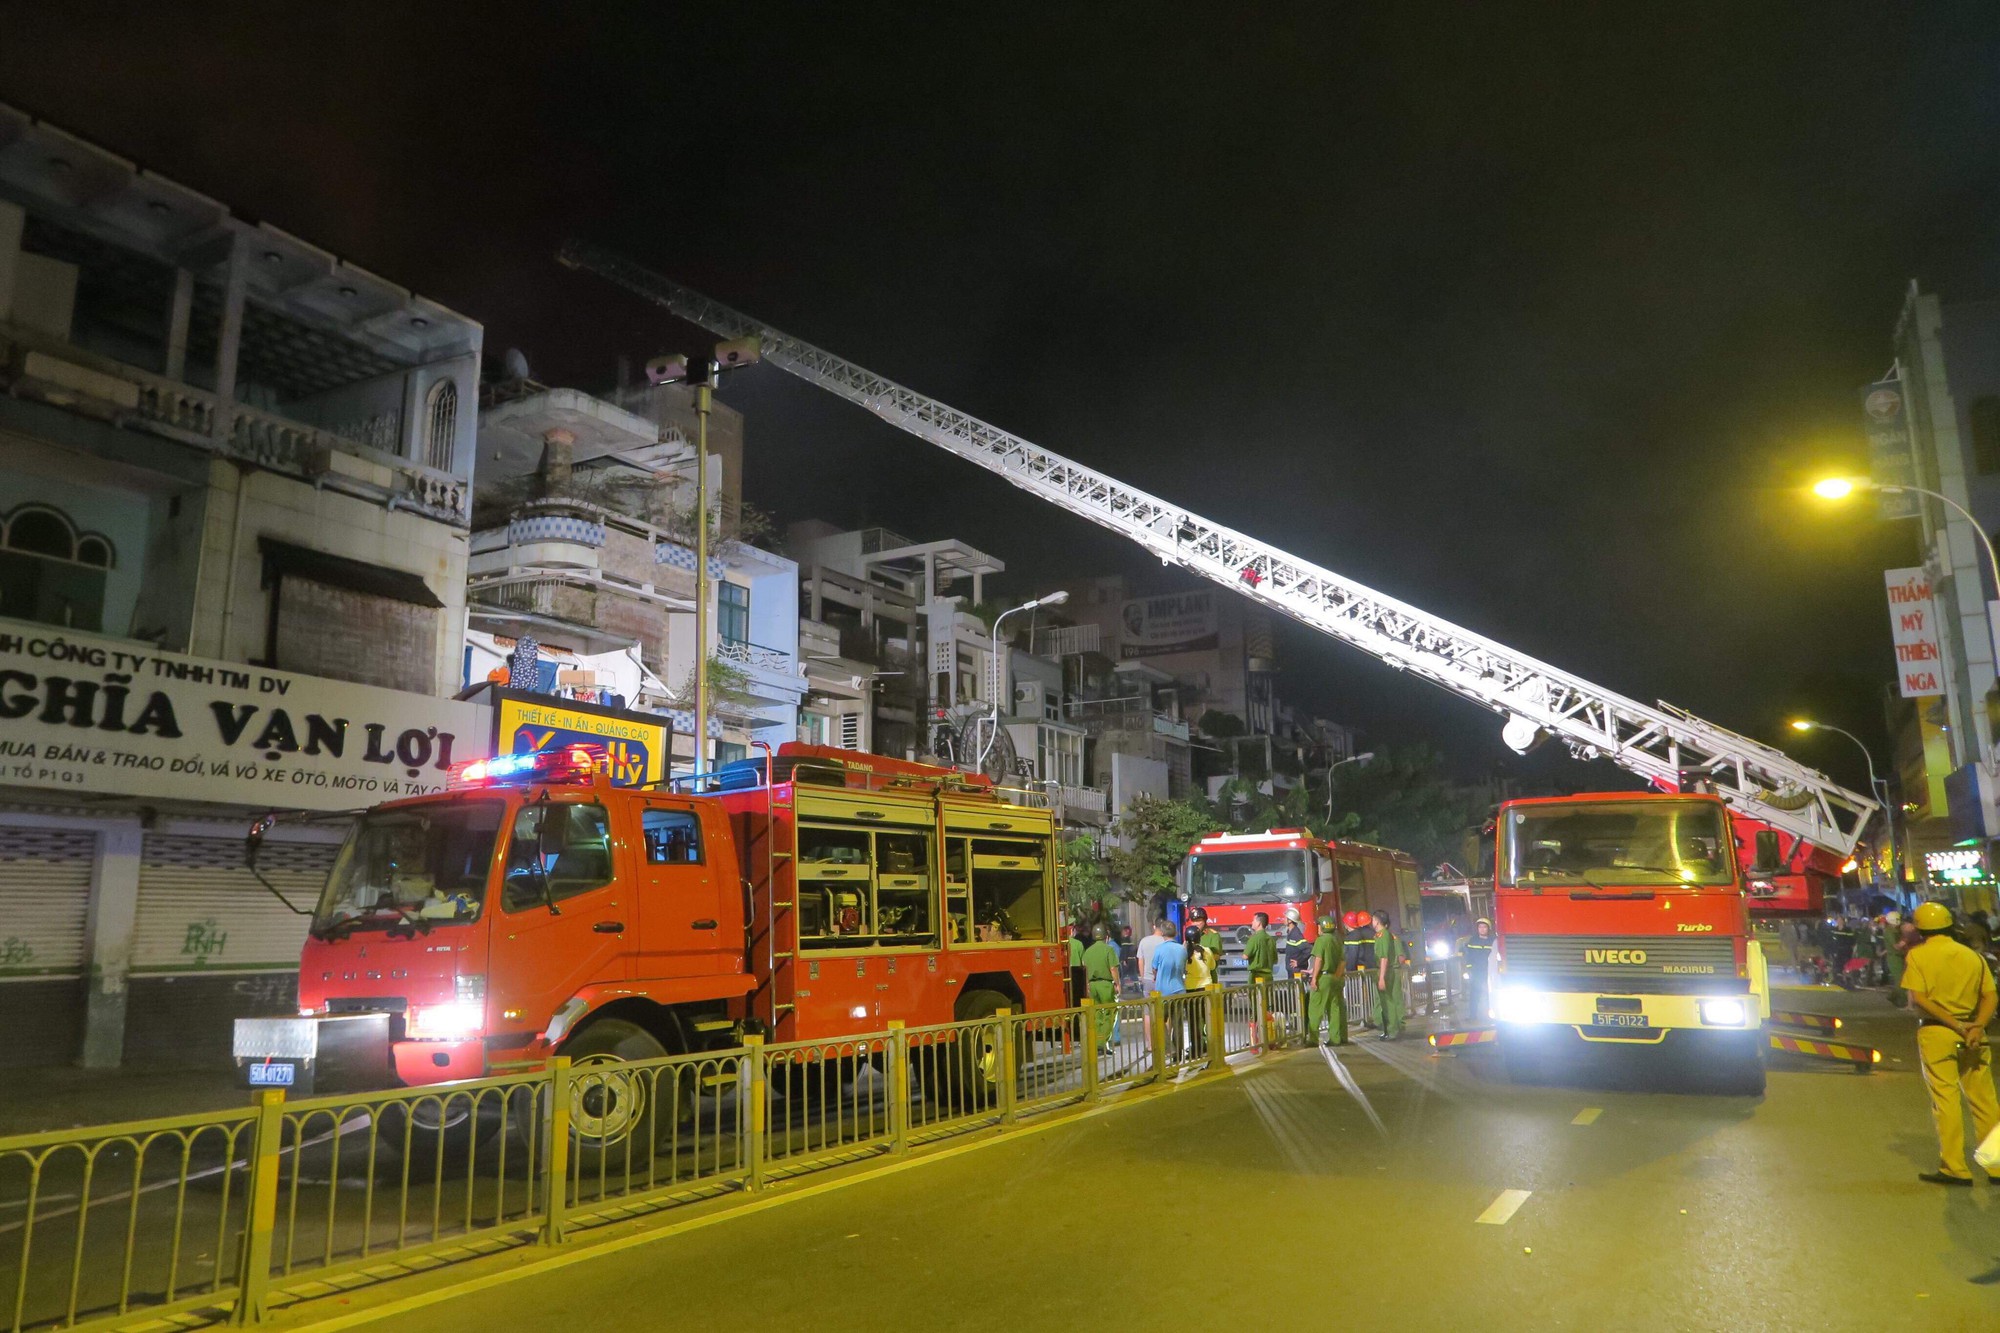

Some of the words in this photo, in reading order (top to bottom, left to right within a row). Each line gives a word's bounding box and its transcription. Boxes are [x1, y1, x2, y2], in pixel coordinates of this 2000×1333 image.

[28, 637, 106, 667] CÔNG
[112, 652, 146, 672] TY
[151, 658, 214, 684] TNHH
[218, 669, 250, 690] TM
[259, 677, 291, 695] DV
[1906, 672, 1937, 691] NGA
[544, 711, 556, 725] KẾ
[563, 717, 572, 728] IN
[596, 721, 628, 737] QUẢNG
[210, 700, 349, 761] VẠN
[363, 722, 456, 778] LỢI
[44, 743, 90, 762] BÁN
[92, 750, 106, 765] &
[112, 752, 164, 771] TRAO
[211, 760, 230, 777] VÁ
[262, 768, 286, 782] XE
[405, 783, 428, 795] TAY
[847, 760, 873, 772] TADANO
[1677, 923, 1713, 932] Turbo
[1585, 949, 1647, 964] IVECO
[1663, 965, 1714, 974] MAGIRUS
[1597, 1014, 1645, 1026] 51F-0122
